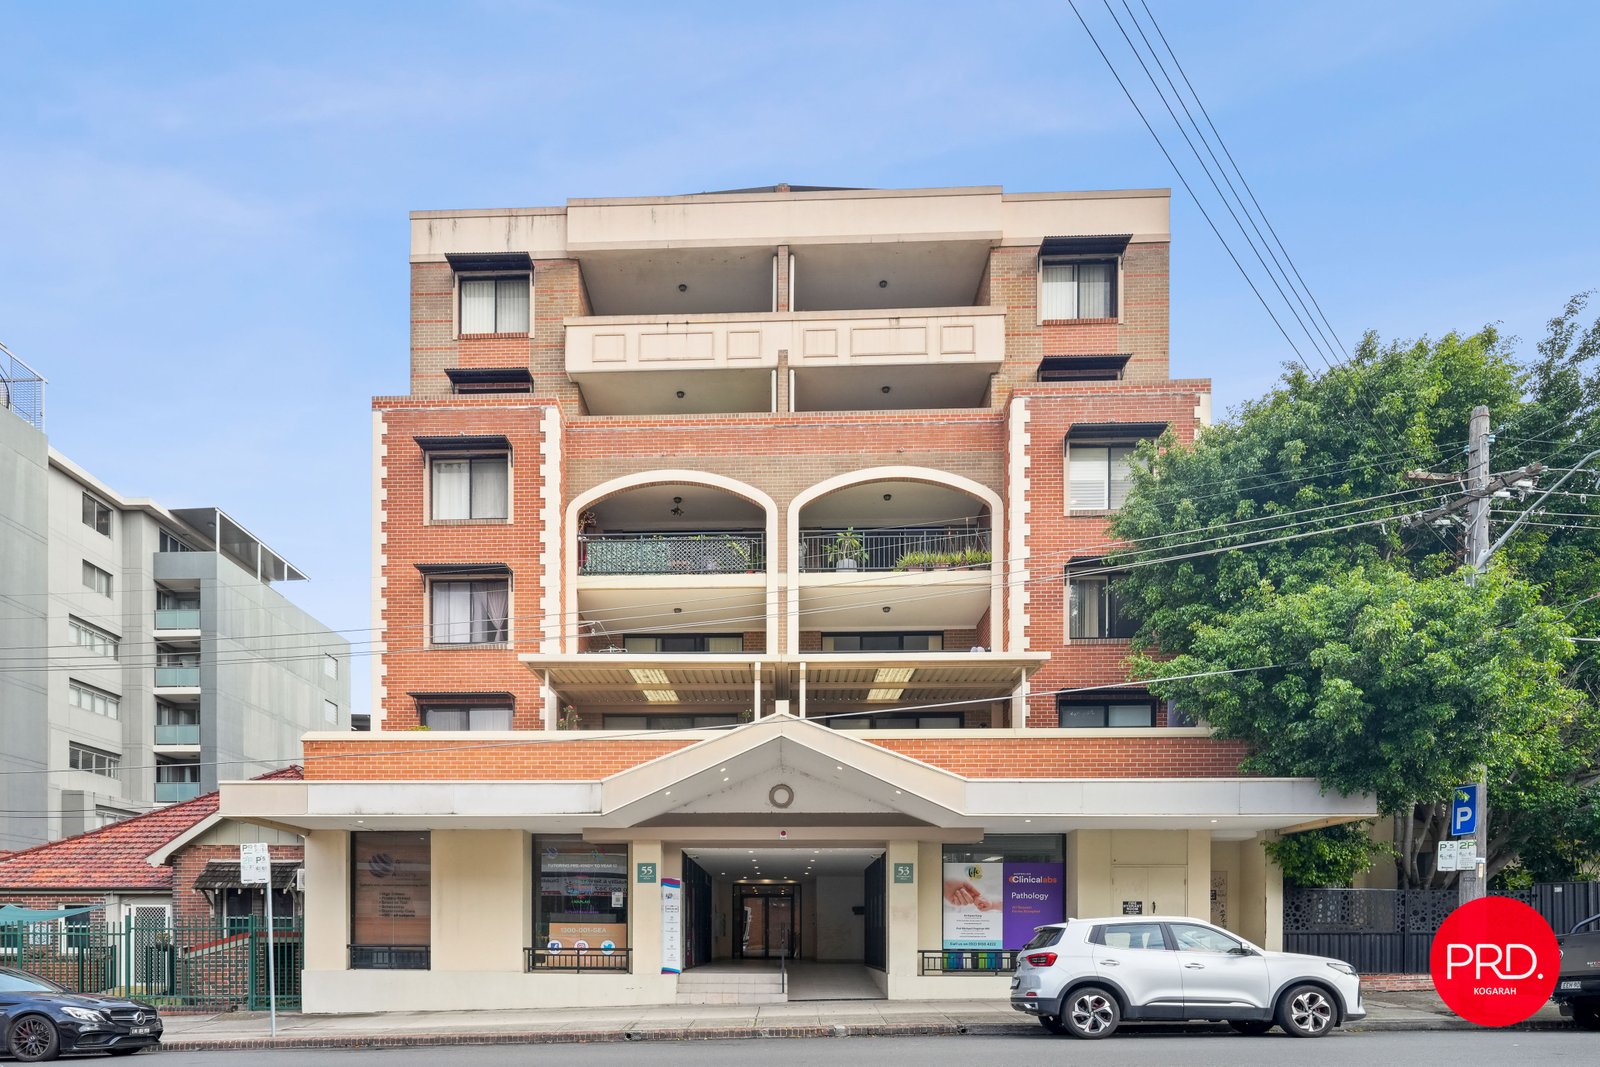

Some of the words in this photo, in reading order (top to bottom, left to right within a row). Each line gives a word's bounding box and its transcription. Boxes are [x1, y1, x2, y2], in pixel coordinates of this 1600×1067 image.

[1456, 806, 1473, 830] P
[1439, 843, 1447, 851] P
[641, 865, 653, 876] 55
[897, 865, 910, 876] 53
[1012, 875, 1057, 884] Clinicalabs
[1011, 891, 1049, 901] Pathology
